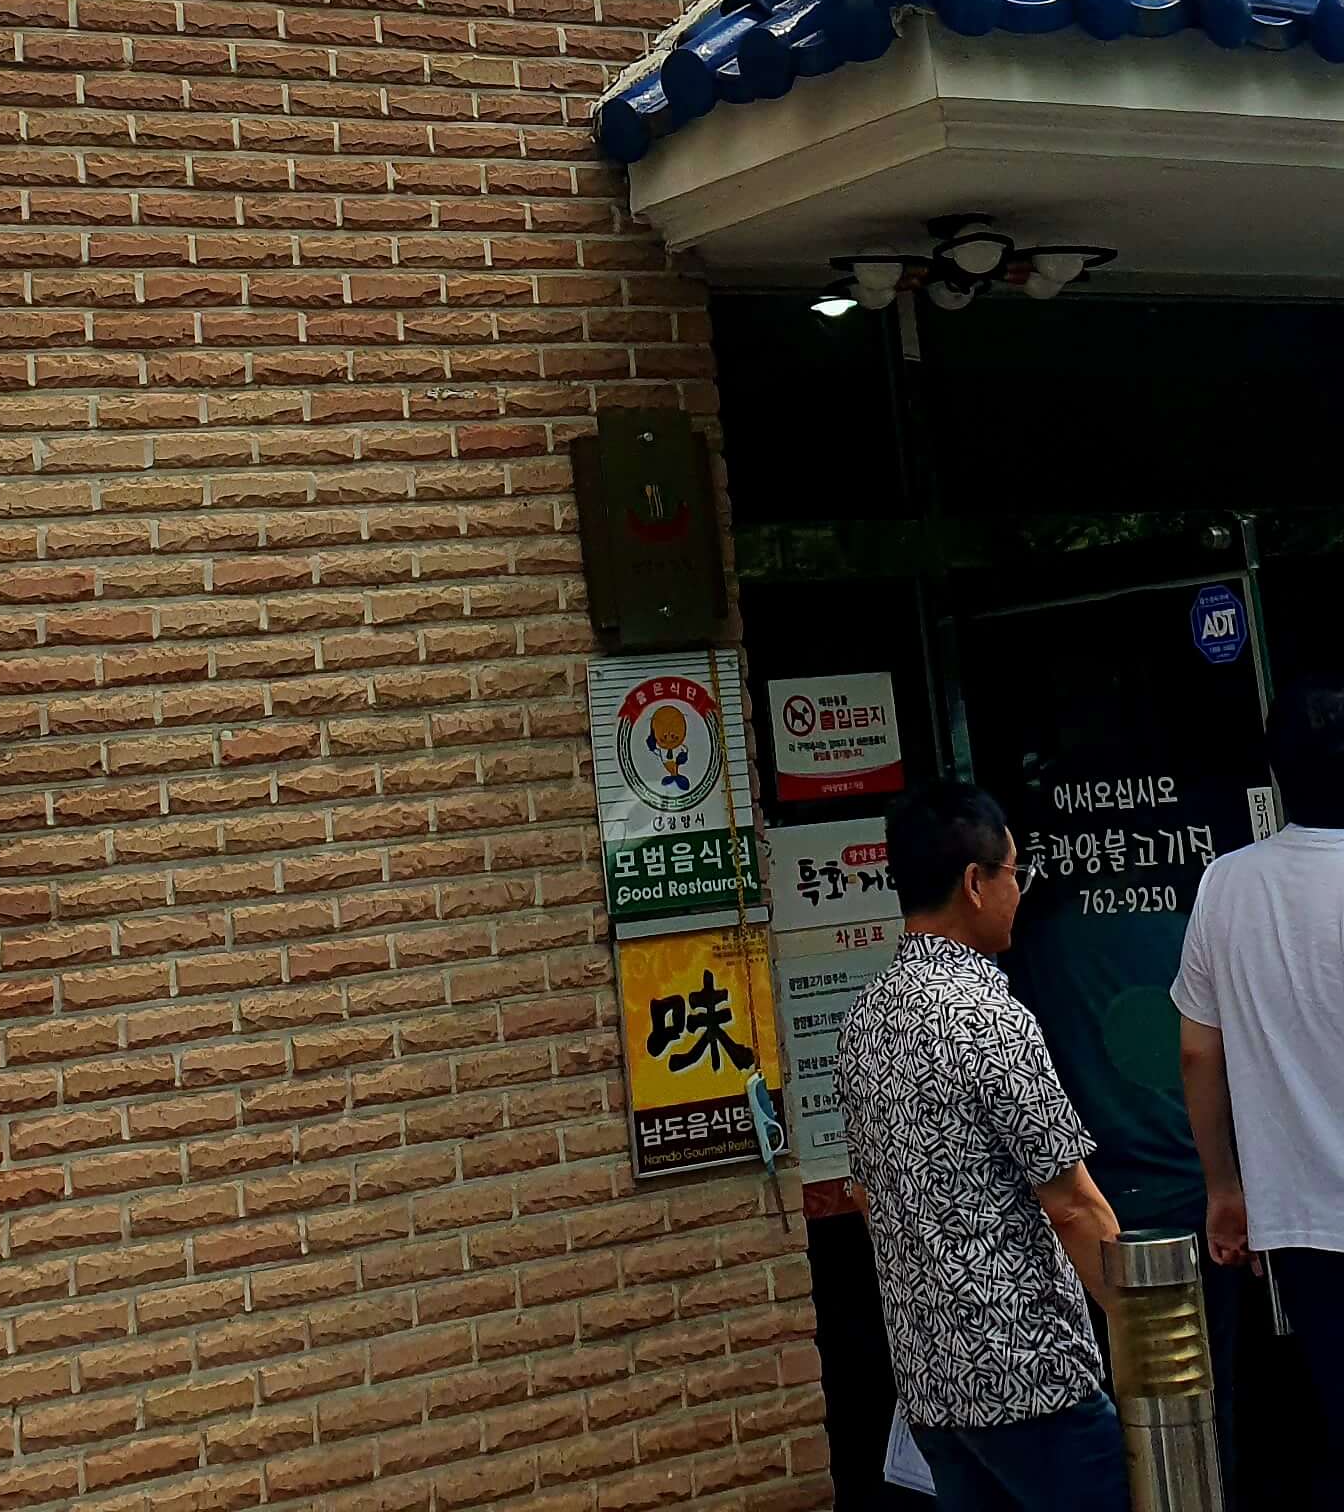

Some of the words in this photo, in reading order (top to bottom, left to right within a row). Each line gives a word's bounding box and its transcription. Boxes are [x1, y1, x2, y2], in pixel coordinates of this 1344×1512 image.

[1201, 608, 1236, 640] ADT
[819, 706, 886, 730] 출입금지
[1054, 776, 1178, 814] 어서오십시오
[849, 847, 888, 862] 광양불고
[1049, 825, 1216, 876] 광양불고기집
[617, 882, 663, 905] Good
[1080, 885, 1177, 915] 762-9250
[647, 969, 755, 1073] 味
[640, 1101, 777, 1148] 남도음식명
[643, 1151, 682, 1166] Namdo
